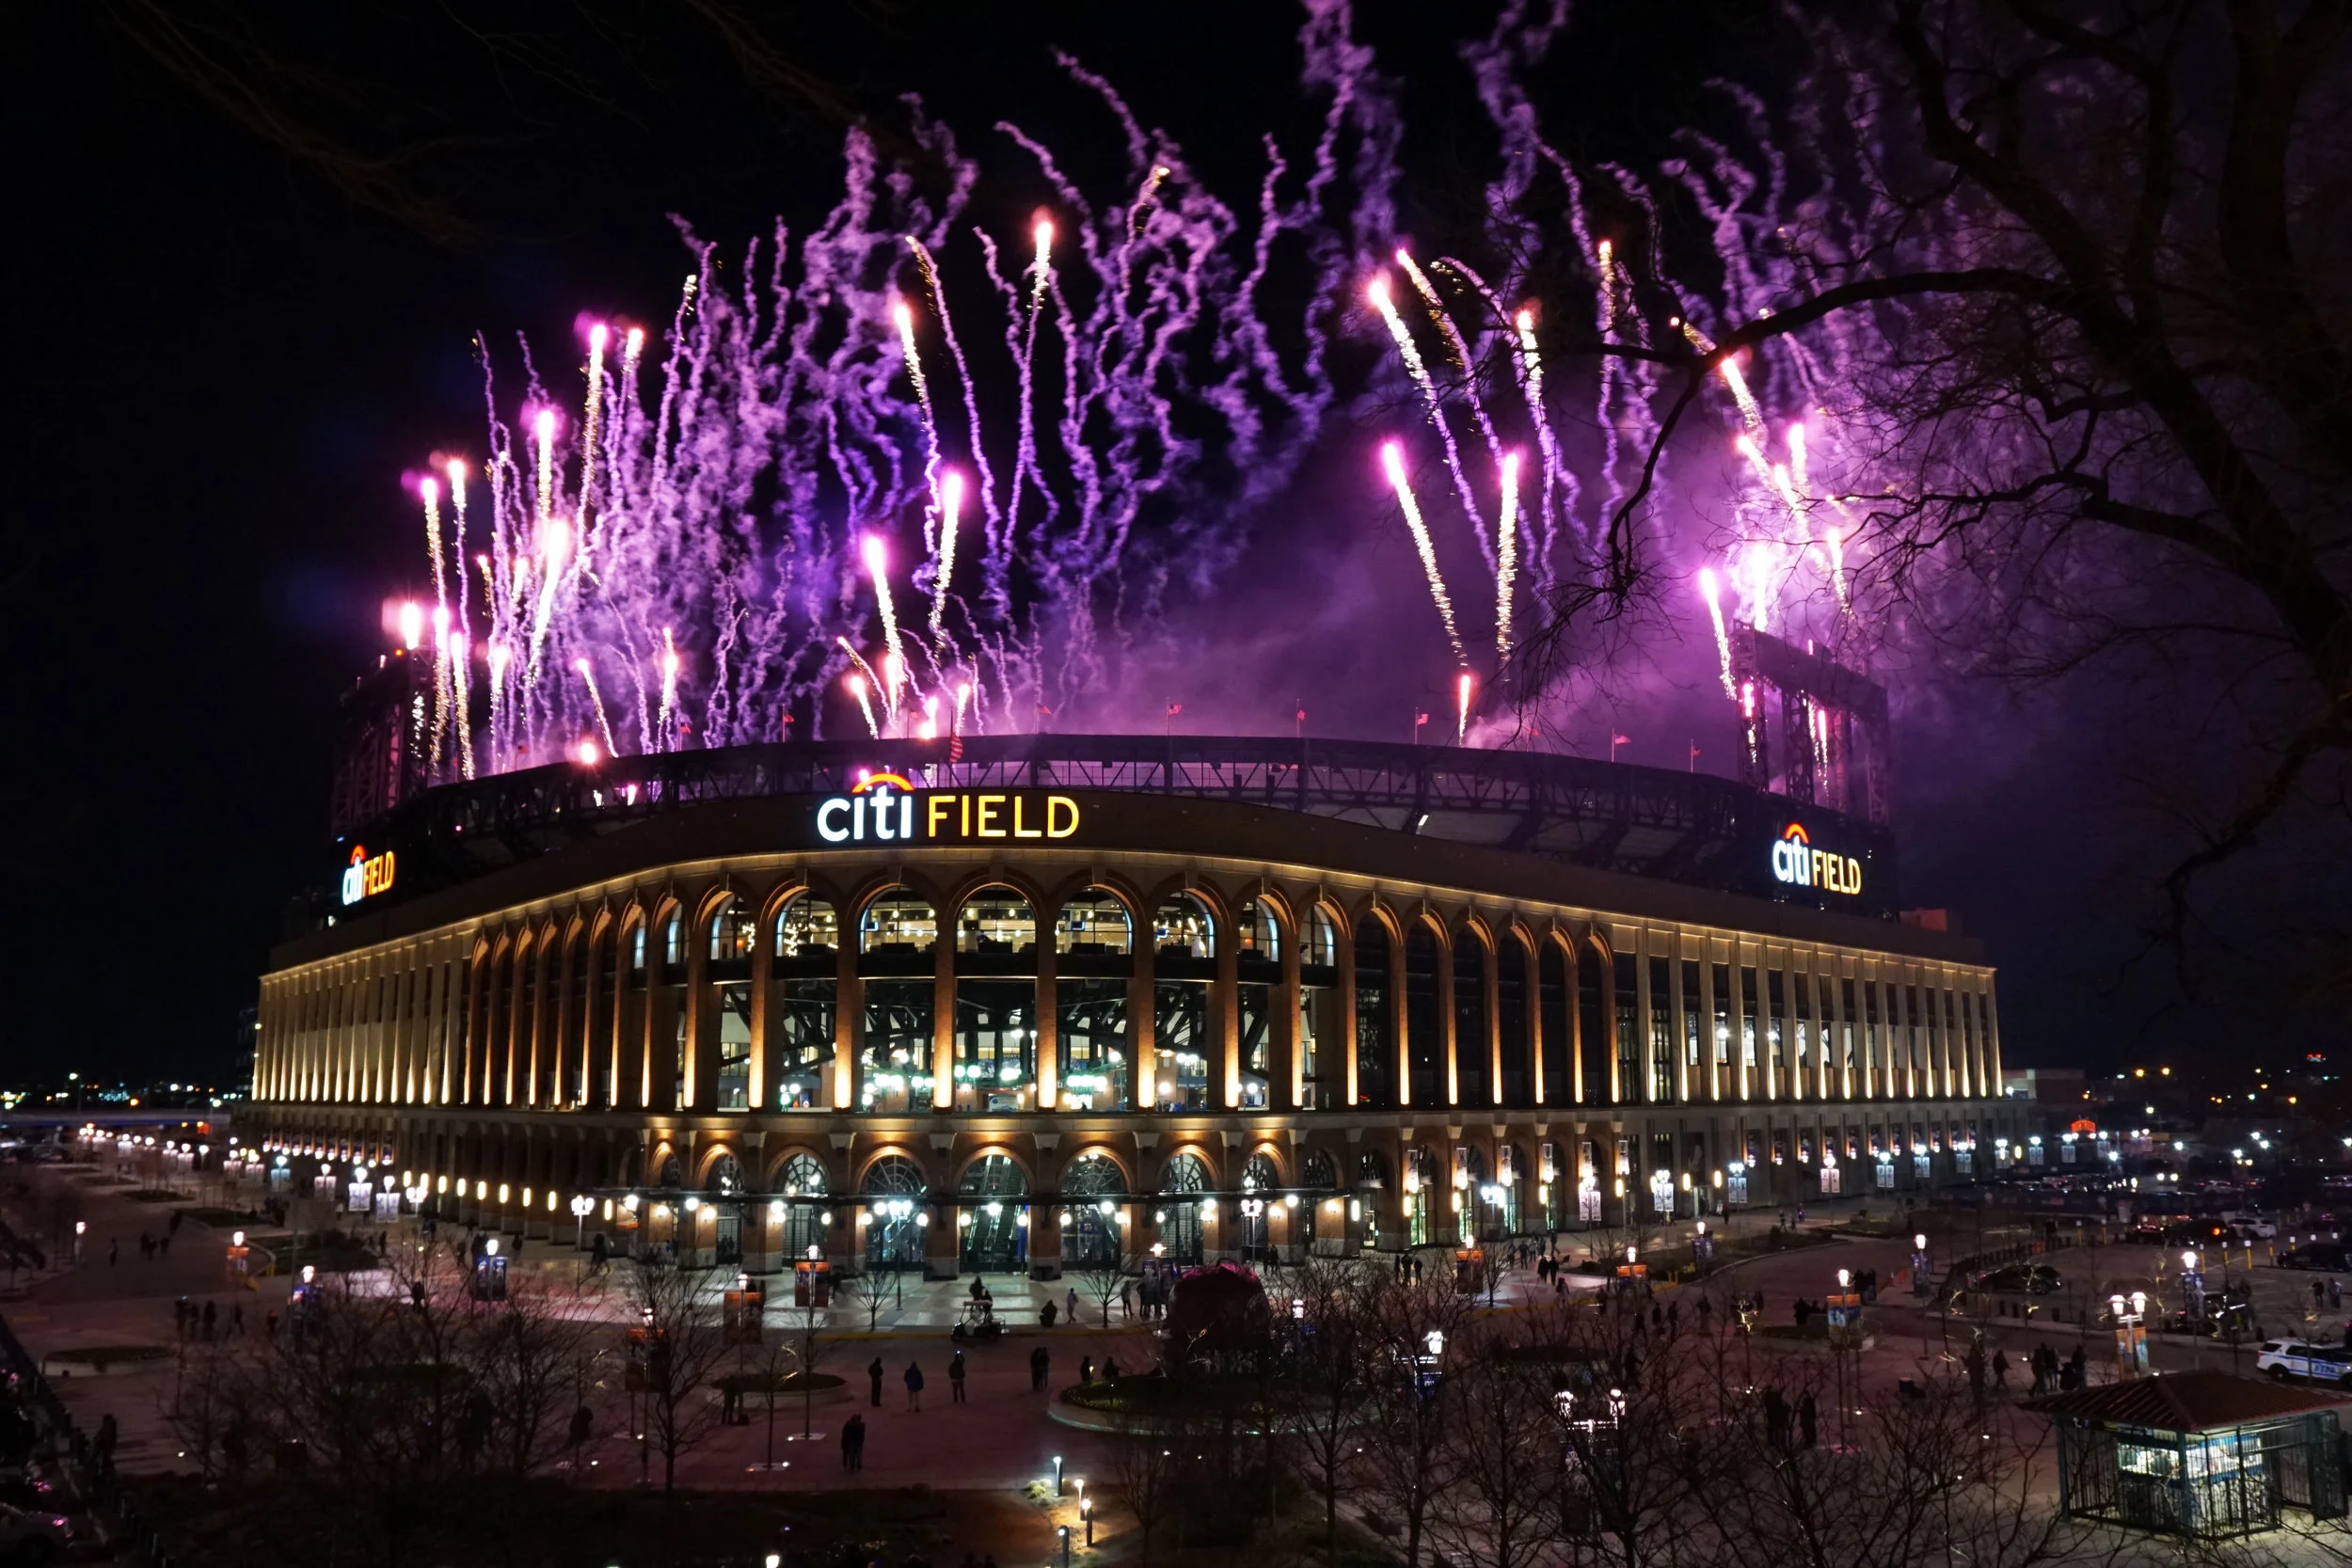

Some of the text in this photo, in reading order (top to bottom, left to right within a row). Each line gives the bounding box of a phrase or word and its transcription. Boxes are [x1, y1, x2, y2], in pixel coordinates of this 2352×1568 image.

[817, 784, 1080, 842] citi FIELD
[362, 850, 394, 897] FIELD
[1772, 834, 1862, 895] citi FIELD
